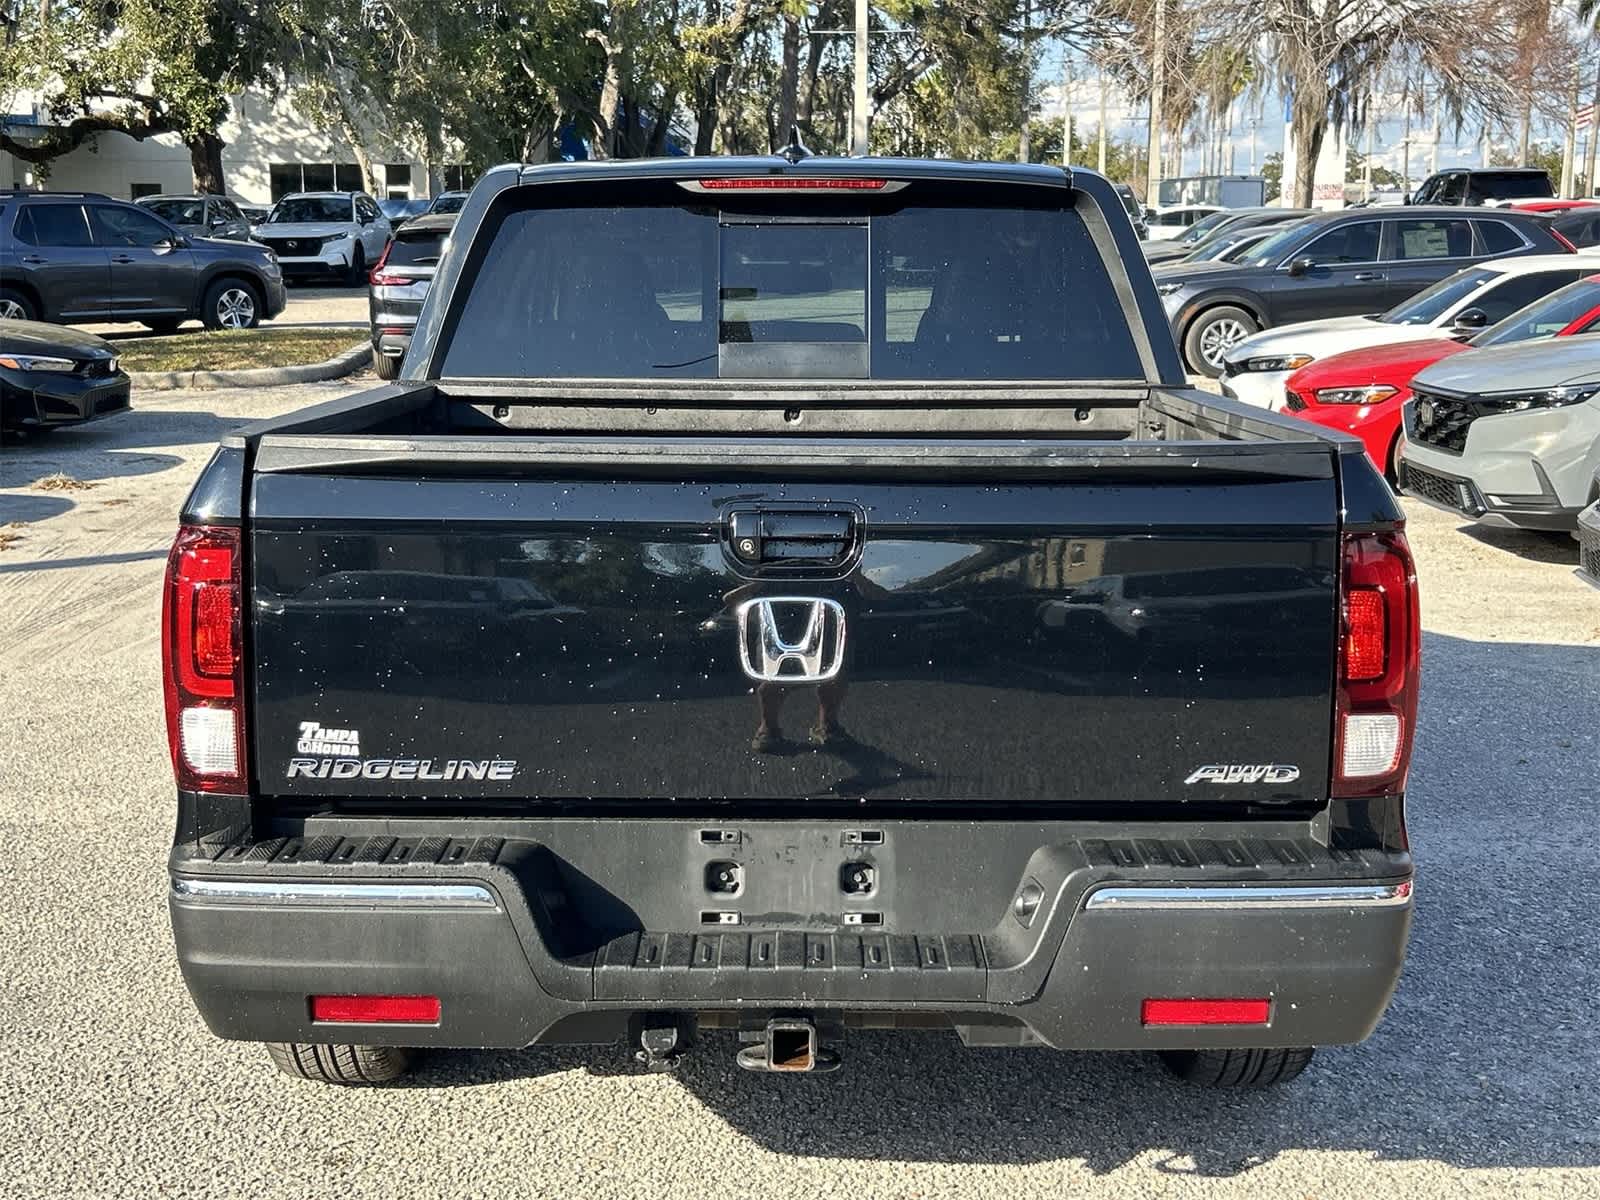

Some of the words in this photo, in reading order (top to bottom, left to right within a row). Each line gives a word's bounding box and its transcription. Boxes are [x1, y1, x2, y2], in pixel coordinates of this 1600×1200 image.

[299, 721, 360, 741] TAMPA
[311, 741, 360, 756] HONDA
[287, 758, 517, 780] RIDGELINE
[1184, 765, 1300, 784] AWD
